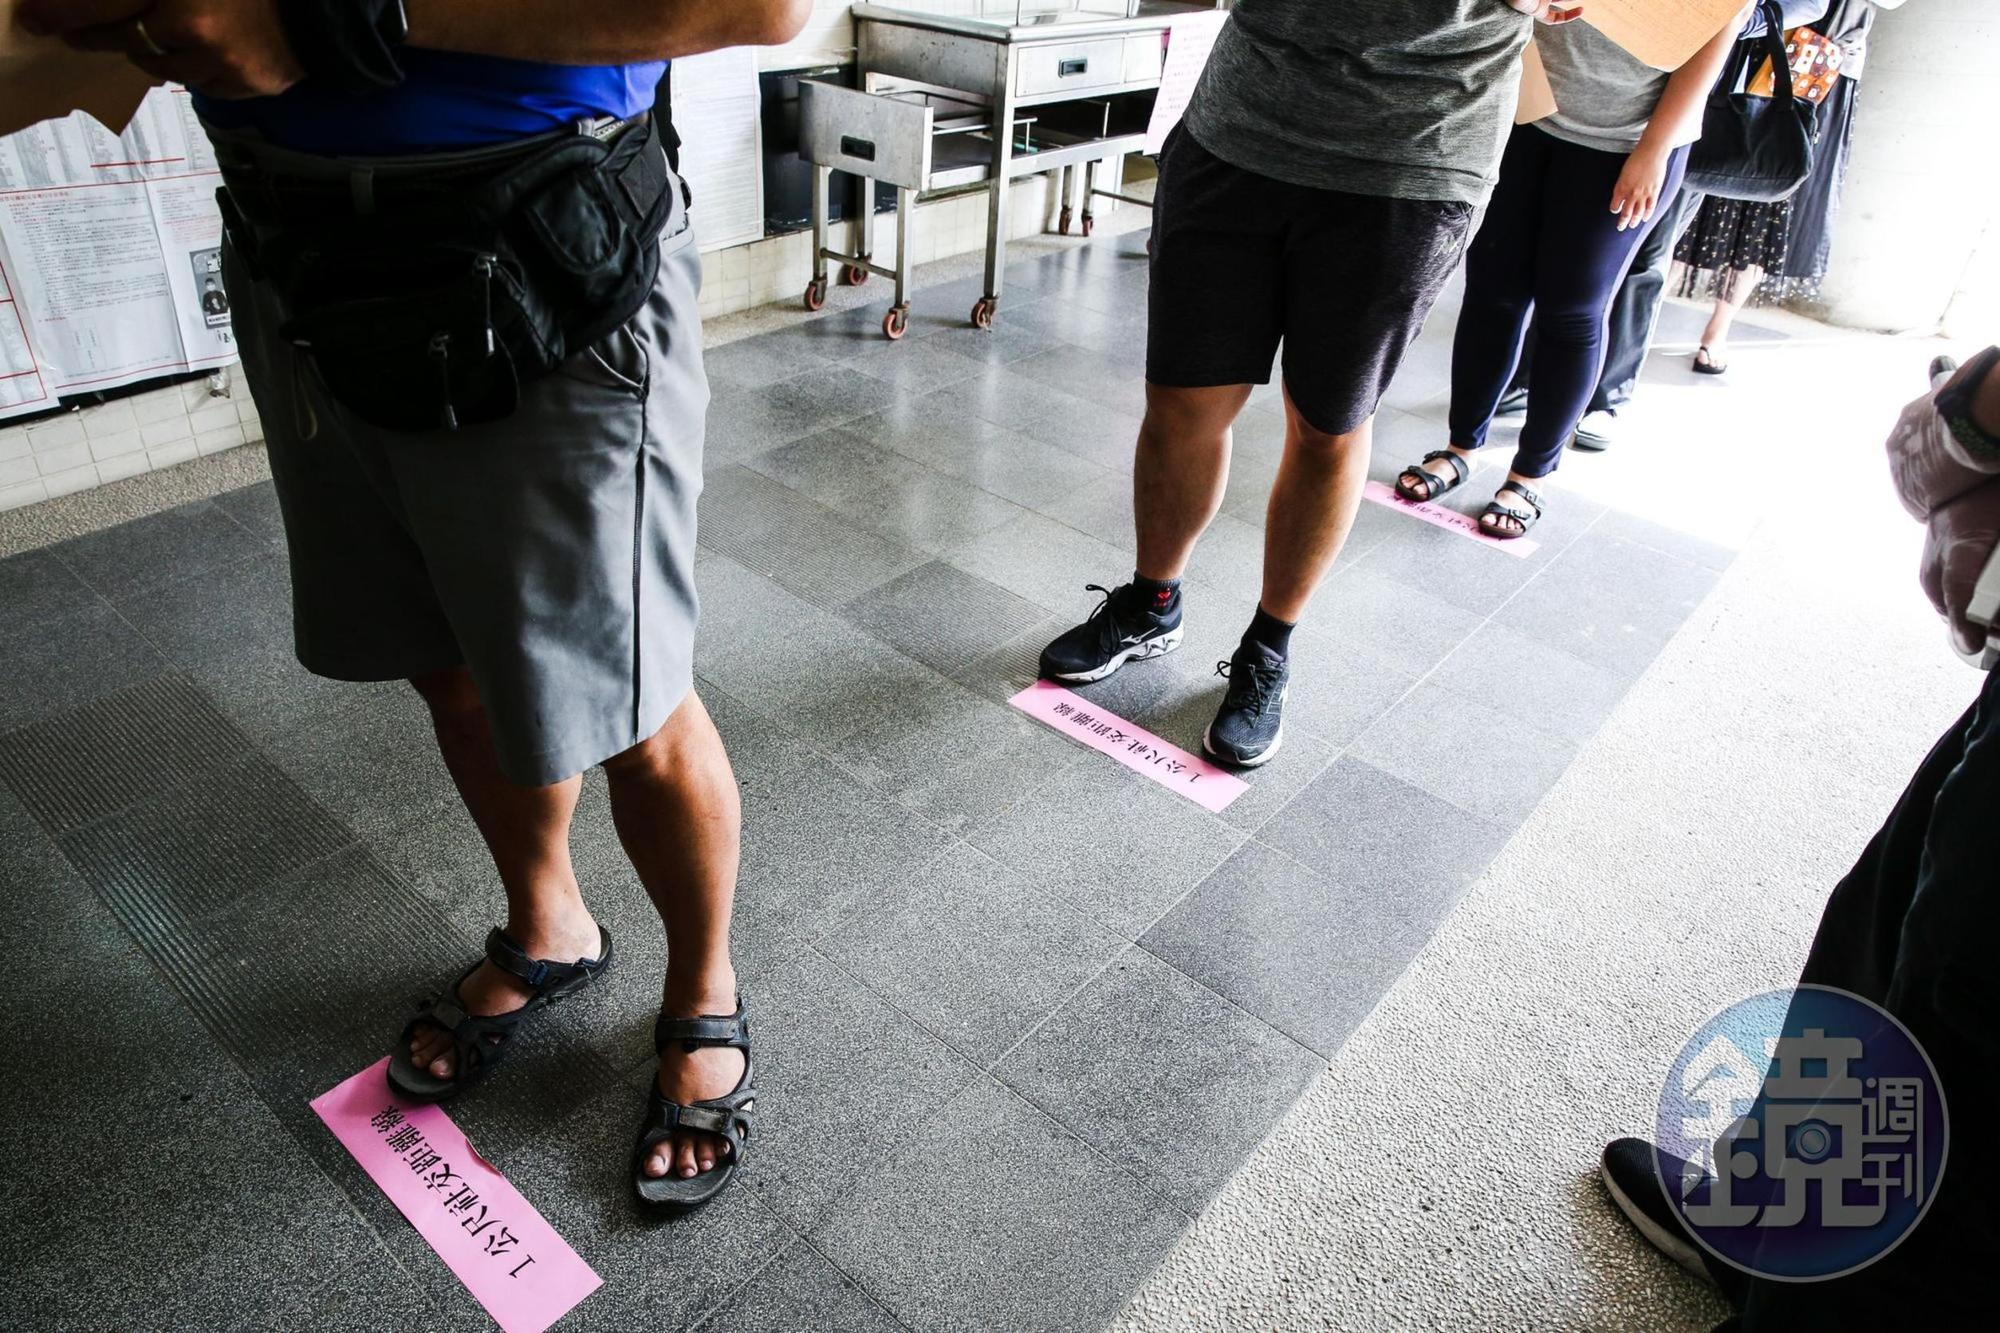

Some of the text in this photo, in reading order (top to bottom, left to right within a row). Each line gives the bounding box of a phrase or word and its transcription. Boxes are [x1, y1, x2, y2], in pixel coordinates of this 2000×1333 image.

[370, 1105, 536, 1278] 1公尺社交距離線
